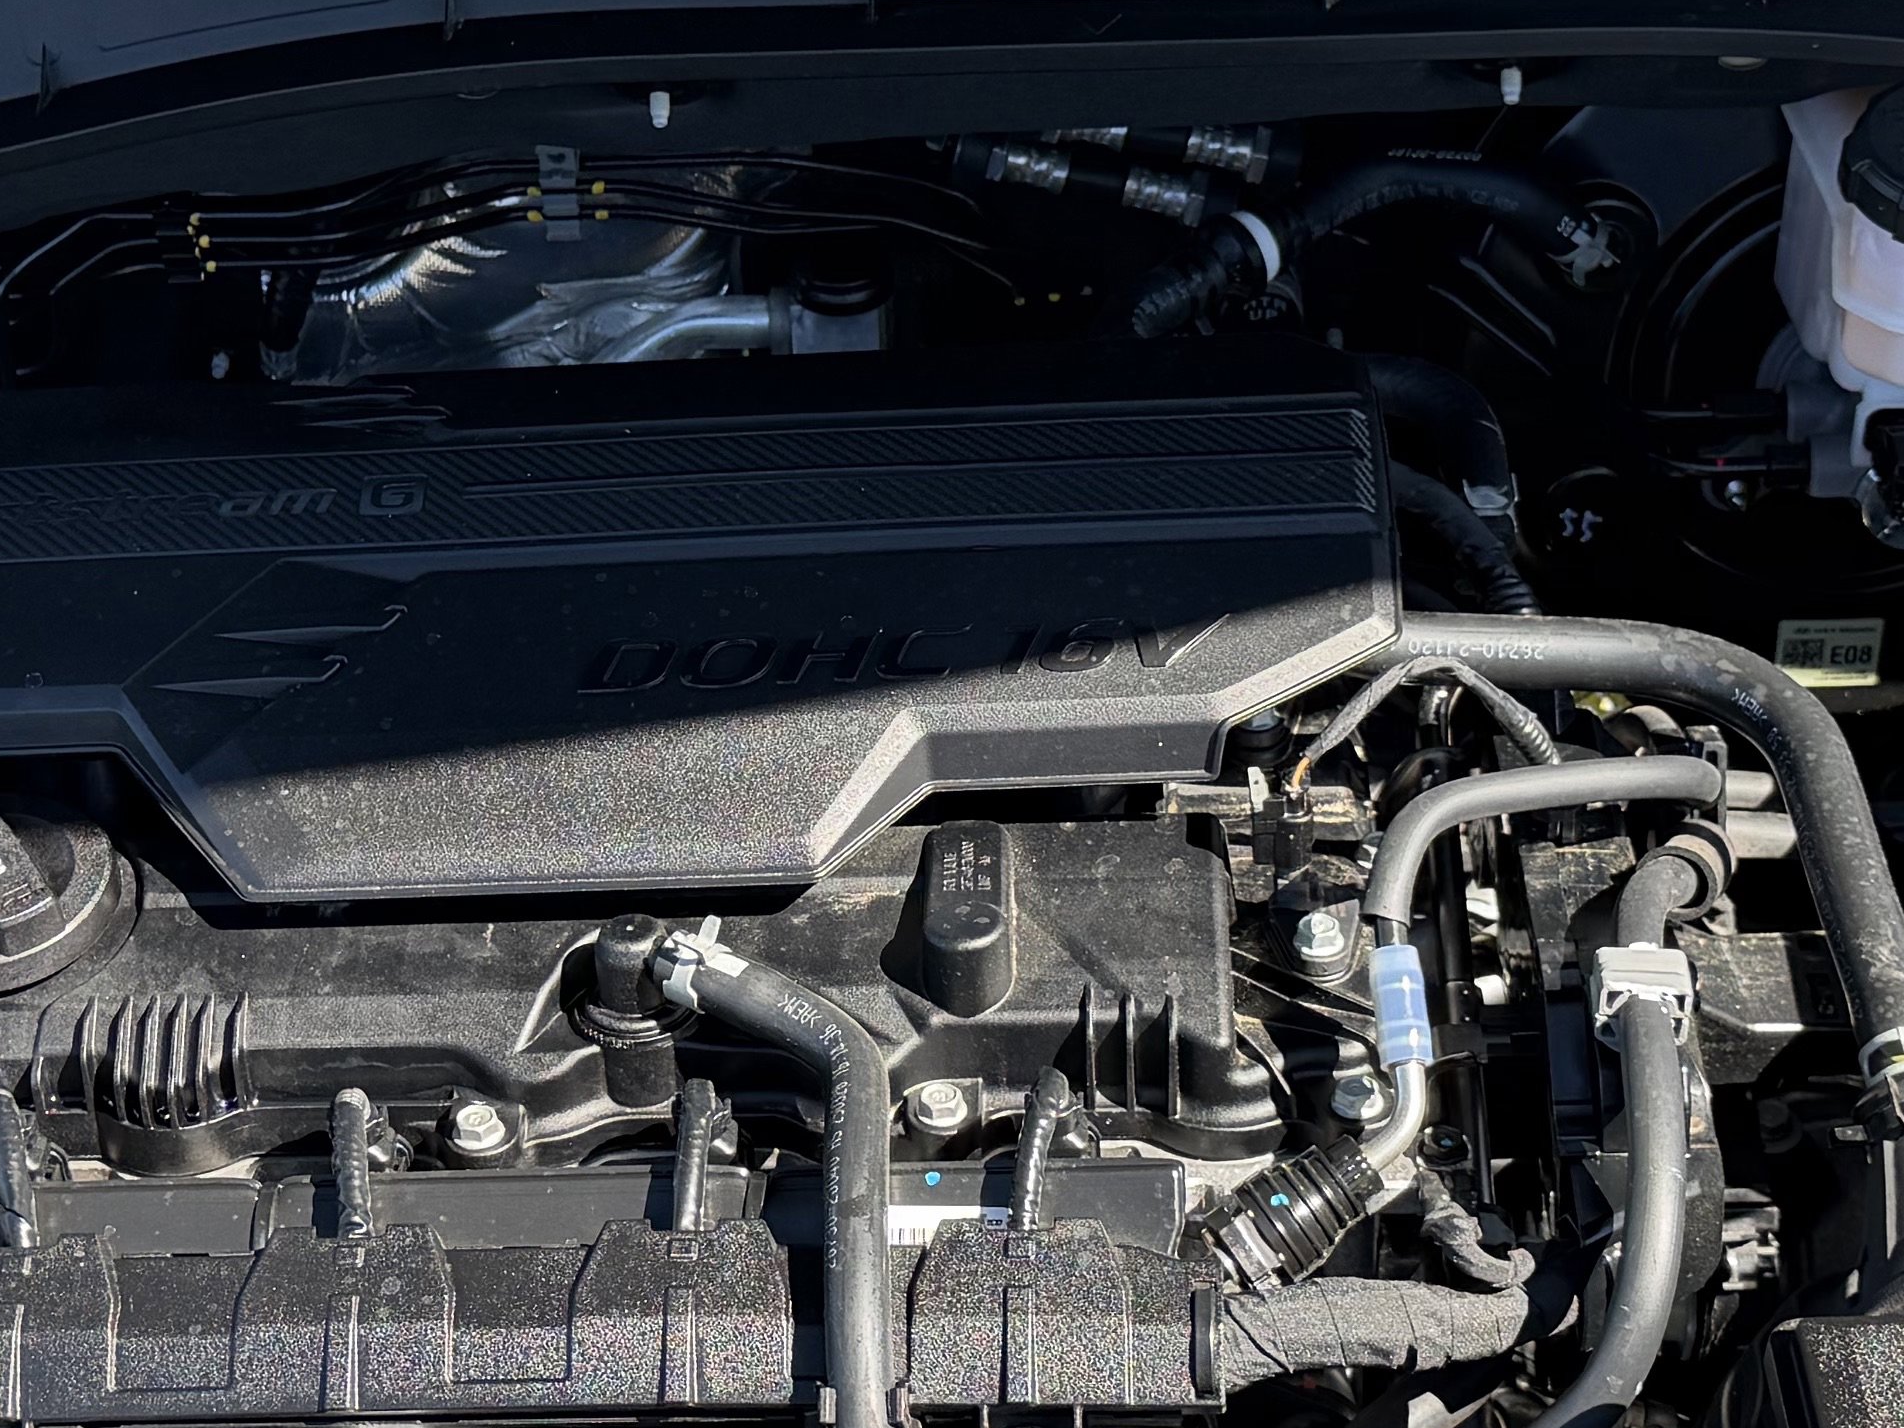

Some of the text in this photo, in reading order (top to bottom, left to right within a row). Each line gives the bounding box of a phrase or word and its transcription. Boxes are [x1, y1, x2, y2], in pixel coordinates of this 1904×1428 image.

[578, 616, 1234, 695] DOHC 16V
[1827, 643, 1875, 666] E08
